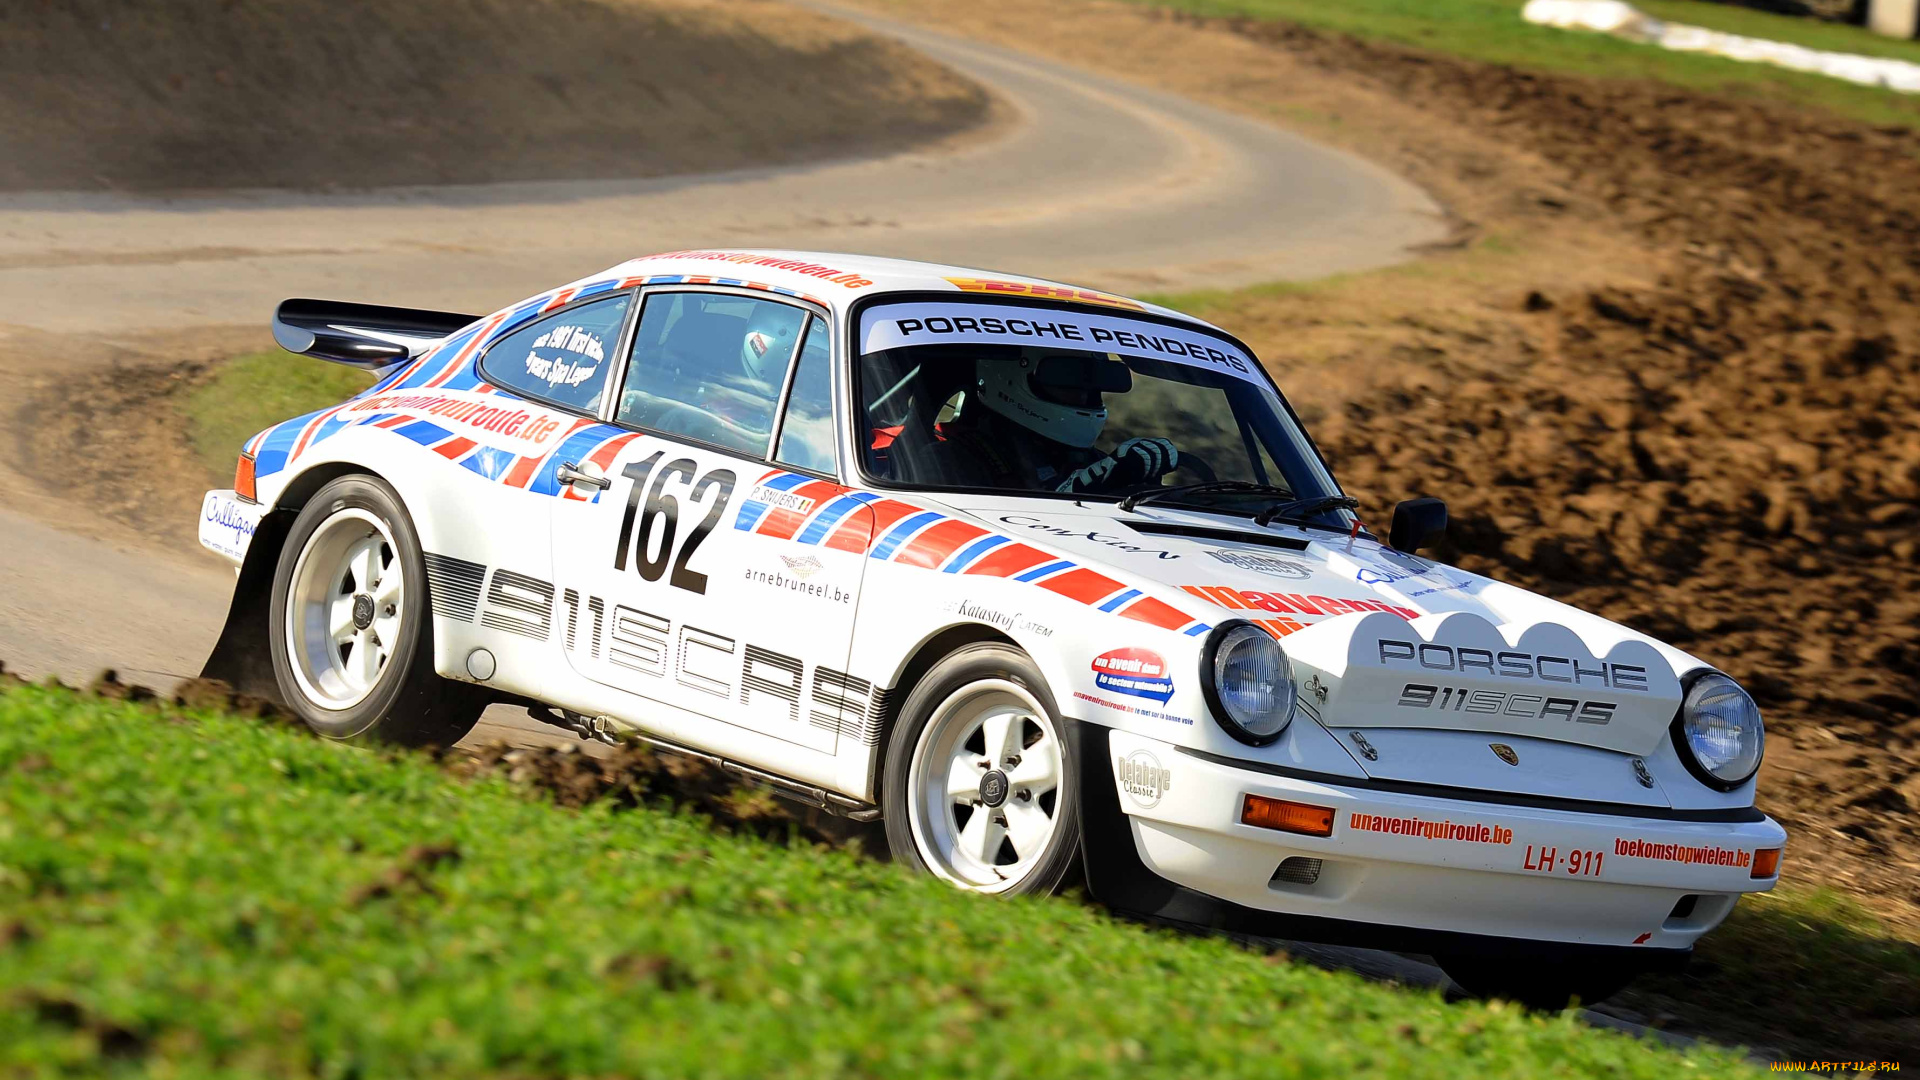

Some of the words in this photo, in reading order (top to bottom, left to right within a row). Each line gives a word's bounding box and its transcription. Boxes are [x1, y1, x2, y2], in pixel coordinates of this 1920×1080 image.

[975, 279, 1118, 305] DHL
[896, 317, 1085, 342] PORSCHE
[1089, 327, 1250, 374] PENDERS
[547, 357, 570, 388] Spa
[760, 489, 799, 509] SNIJERS
[614, 450, 737, 595] 162
[745, 568, 850, 603] arnebruneel.be
[1095, 657, 1108, 667] un
[1108, 657, 1143, 673] avenir
[1378, 639, 1648, 691] PORSCHE
[1107, 677, 1134, 688] secteur
[1119, 757, 1170, 799] Delahaye
[1124, 779, 1154, 798] Classic
[1350, 813, 1513, 845] unavenirquiroule.be
[1614, 837, 1751, 868] toekomstopwielen.be
